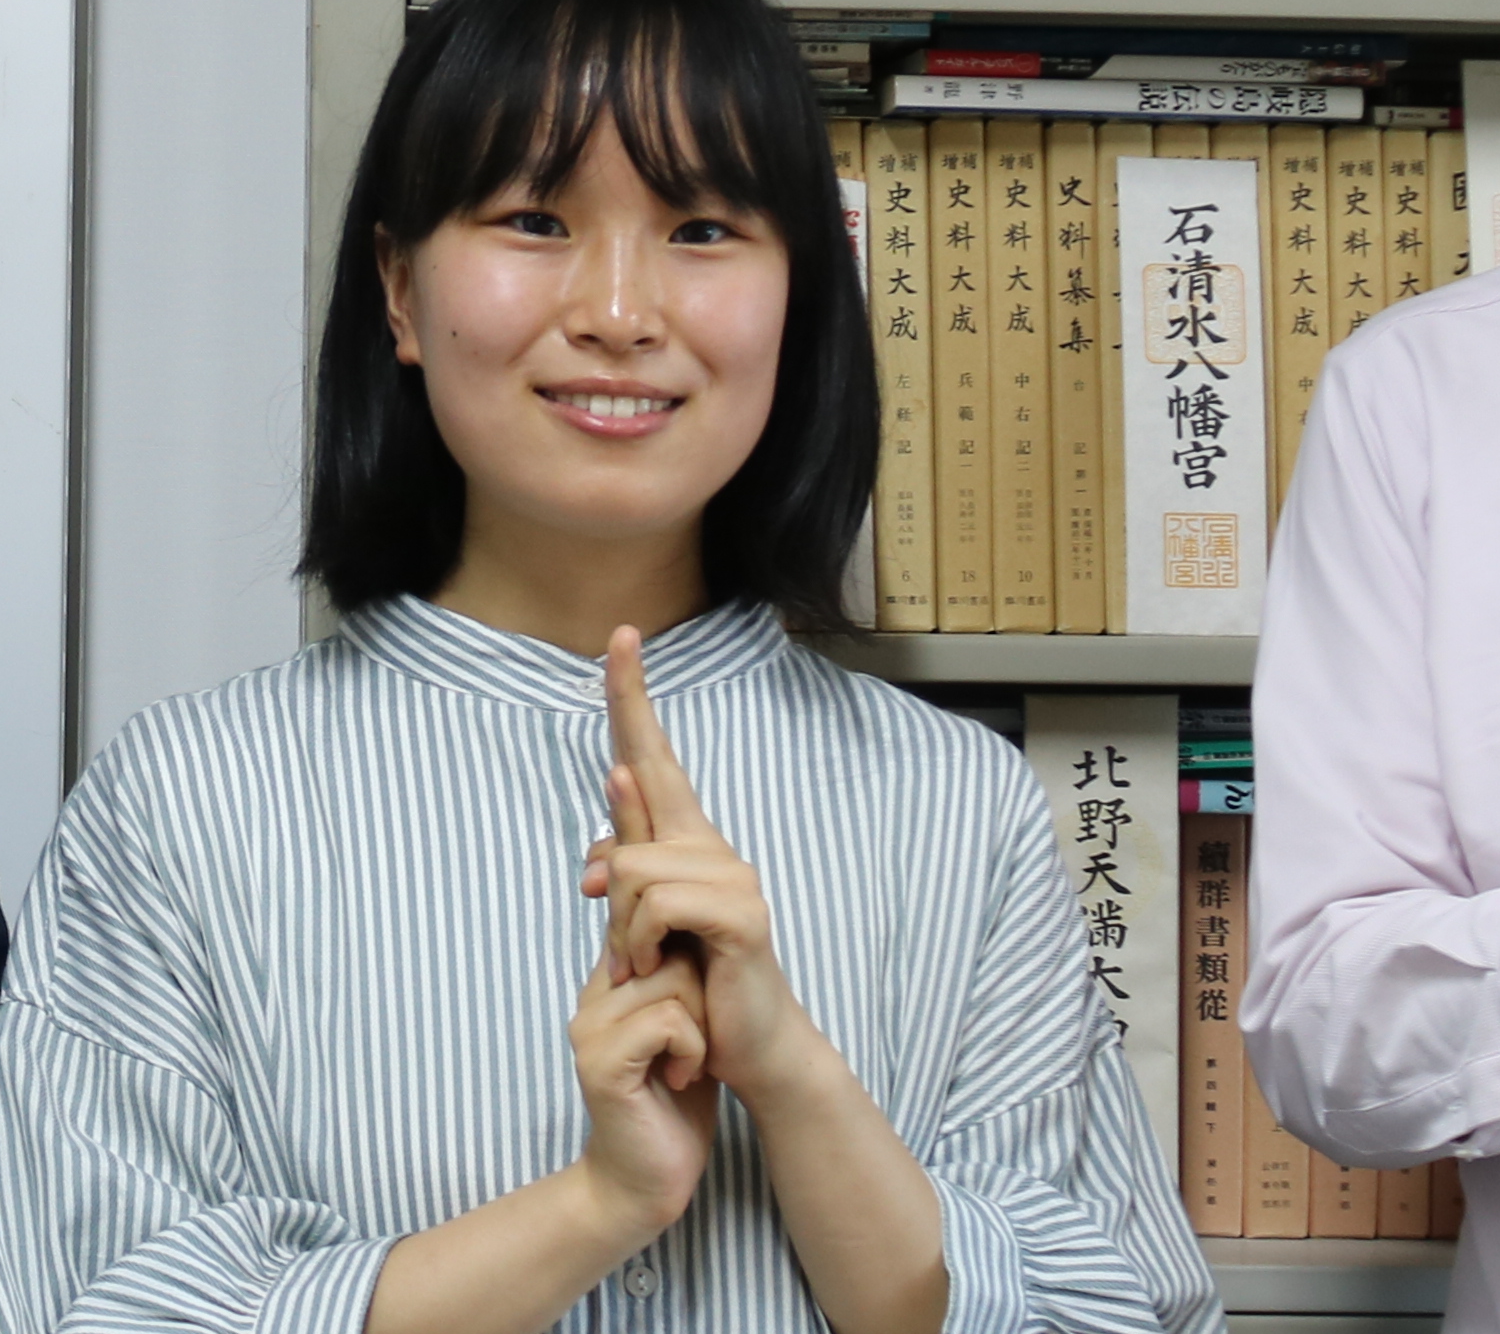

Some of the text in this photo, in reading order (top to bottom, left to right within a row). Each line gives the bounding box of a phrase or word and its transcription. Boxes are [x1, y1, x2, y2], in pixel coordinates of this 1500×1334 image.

[884, 181, 920, 342] 史料大成
[946, 178, 979, 337] 史料大成
[1003, 178, 1036, 337] 史料大成
[1164, 202, 1232, 492] 石清水八幡宮
[1073, 745, 1133, 1048] 北野天満大
